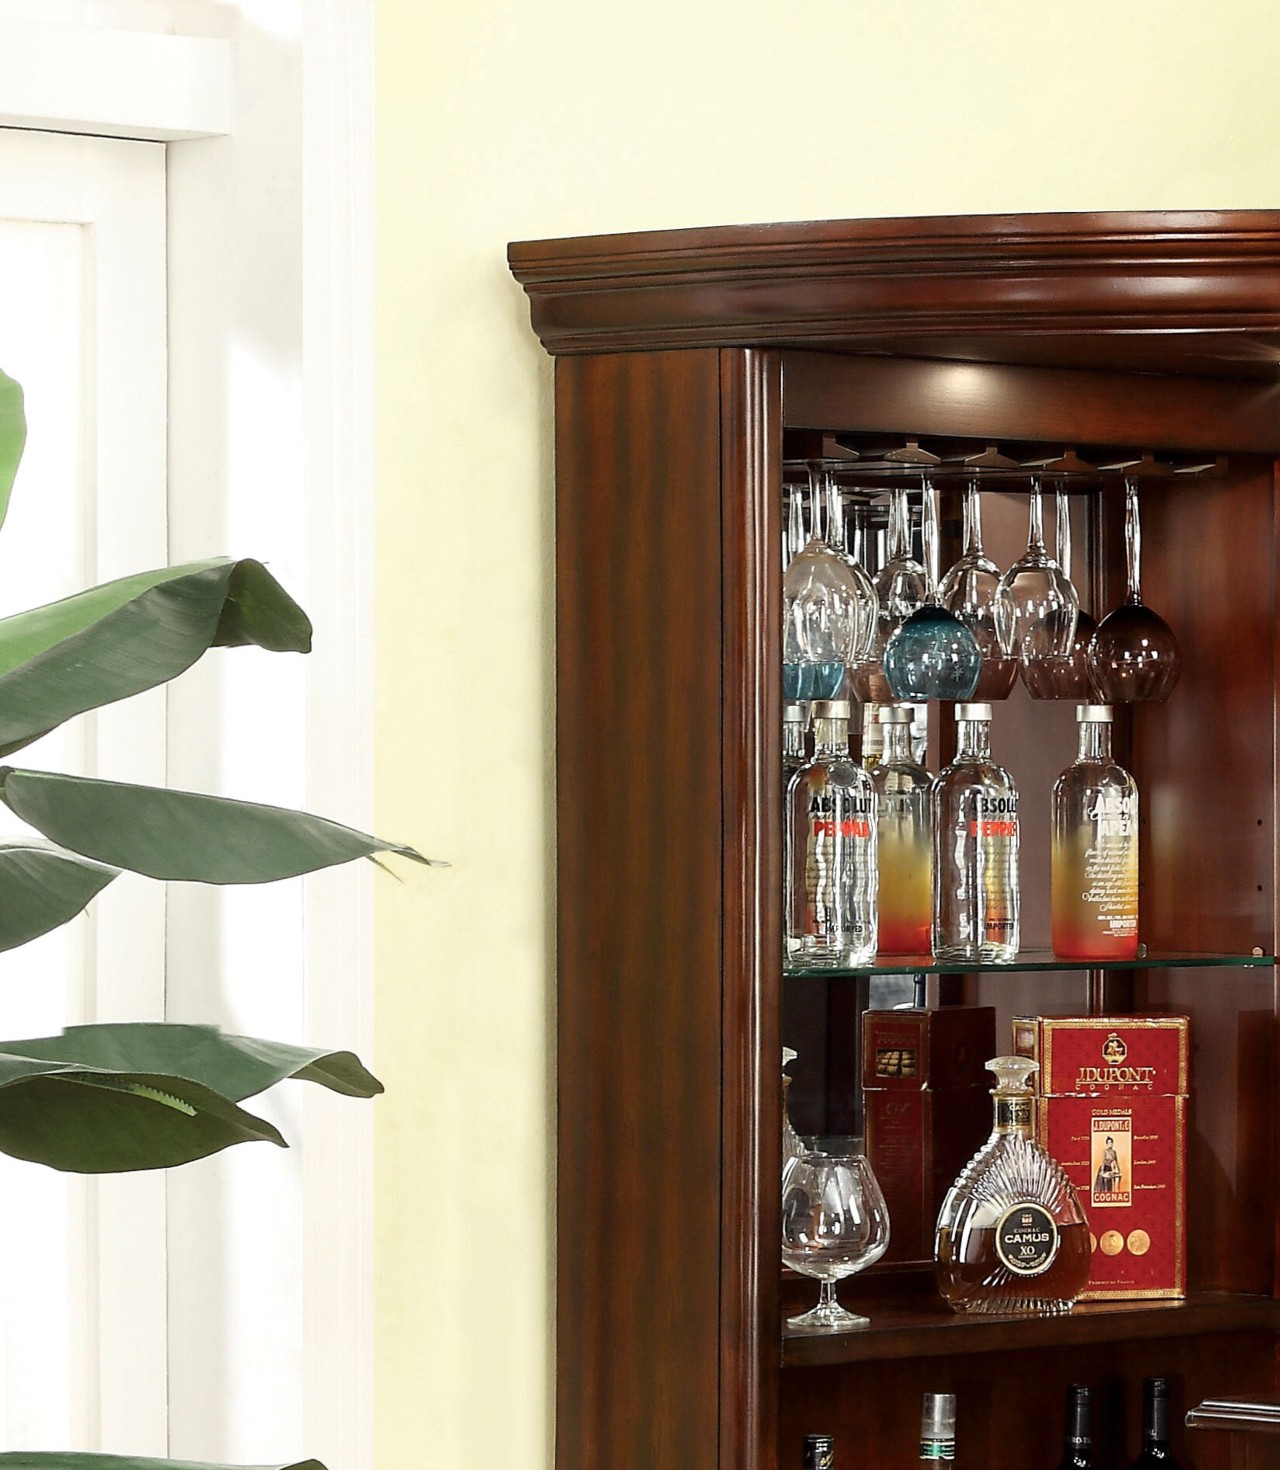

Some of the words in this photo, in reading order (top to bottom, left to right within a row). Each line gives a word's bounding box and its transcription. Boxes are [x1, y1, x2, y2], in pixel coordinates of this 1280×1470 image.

[1076, 1067, 1154, 1082] J.DUPONT
[1094, 1192, 1129, 1202] COGNAC
[1004, 1233, 1050, 1244] CAMUS
[1020, 1245, 1036, 1256] XO
